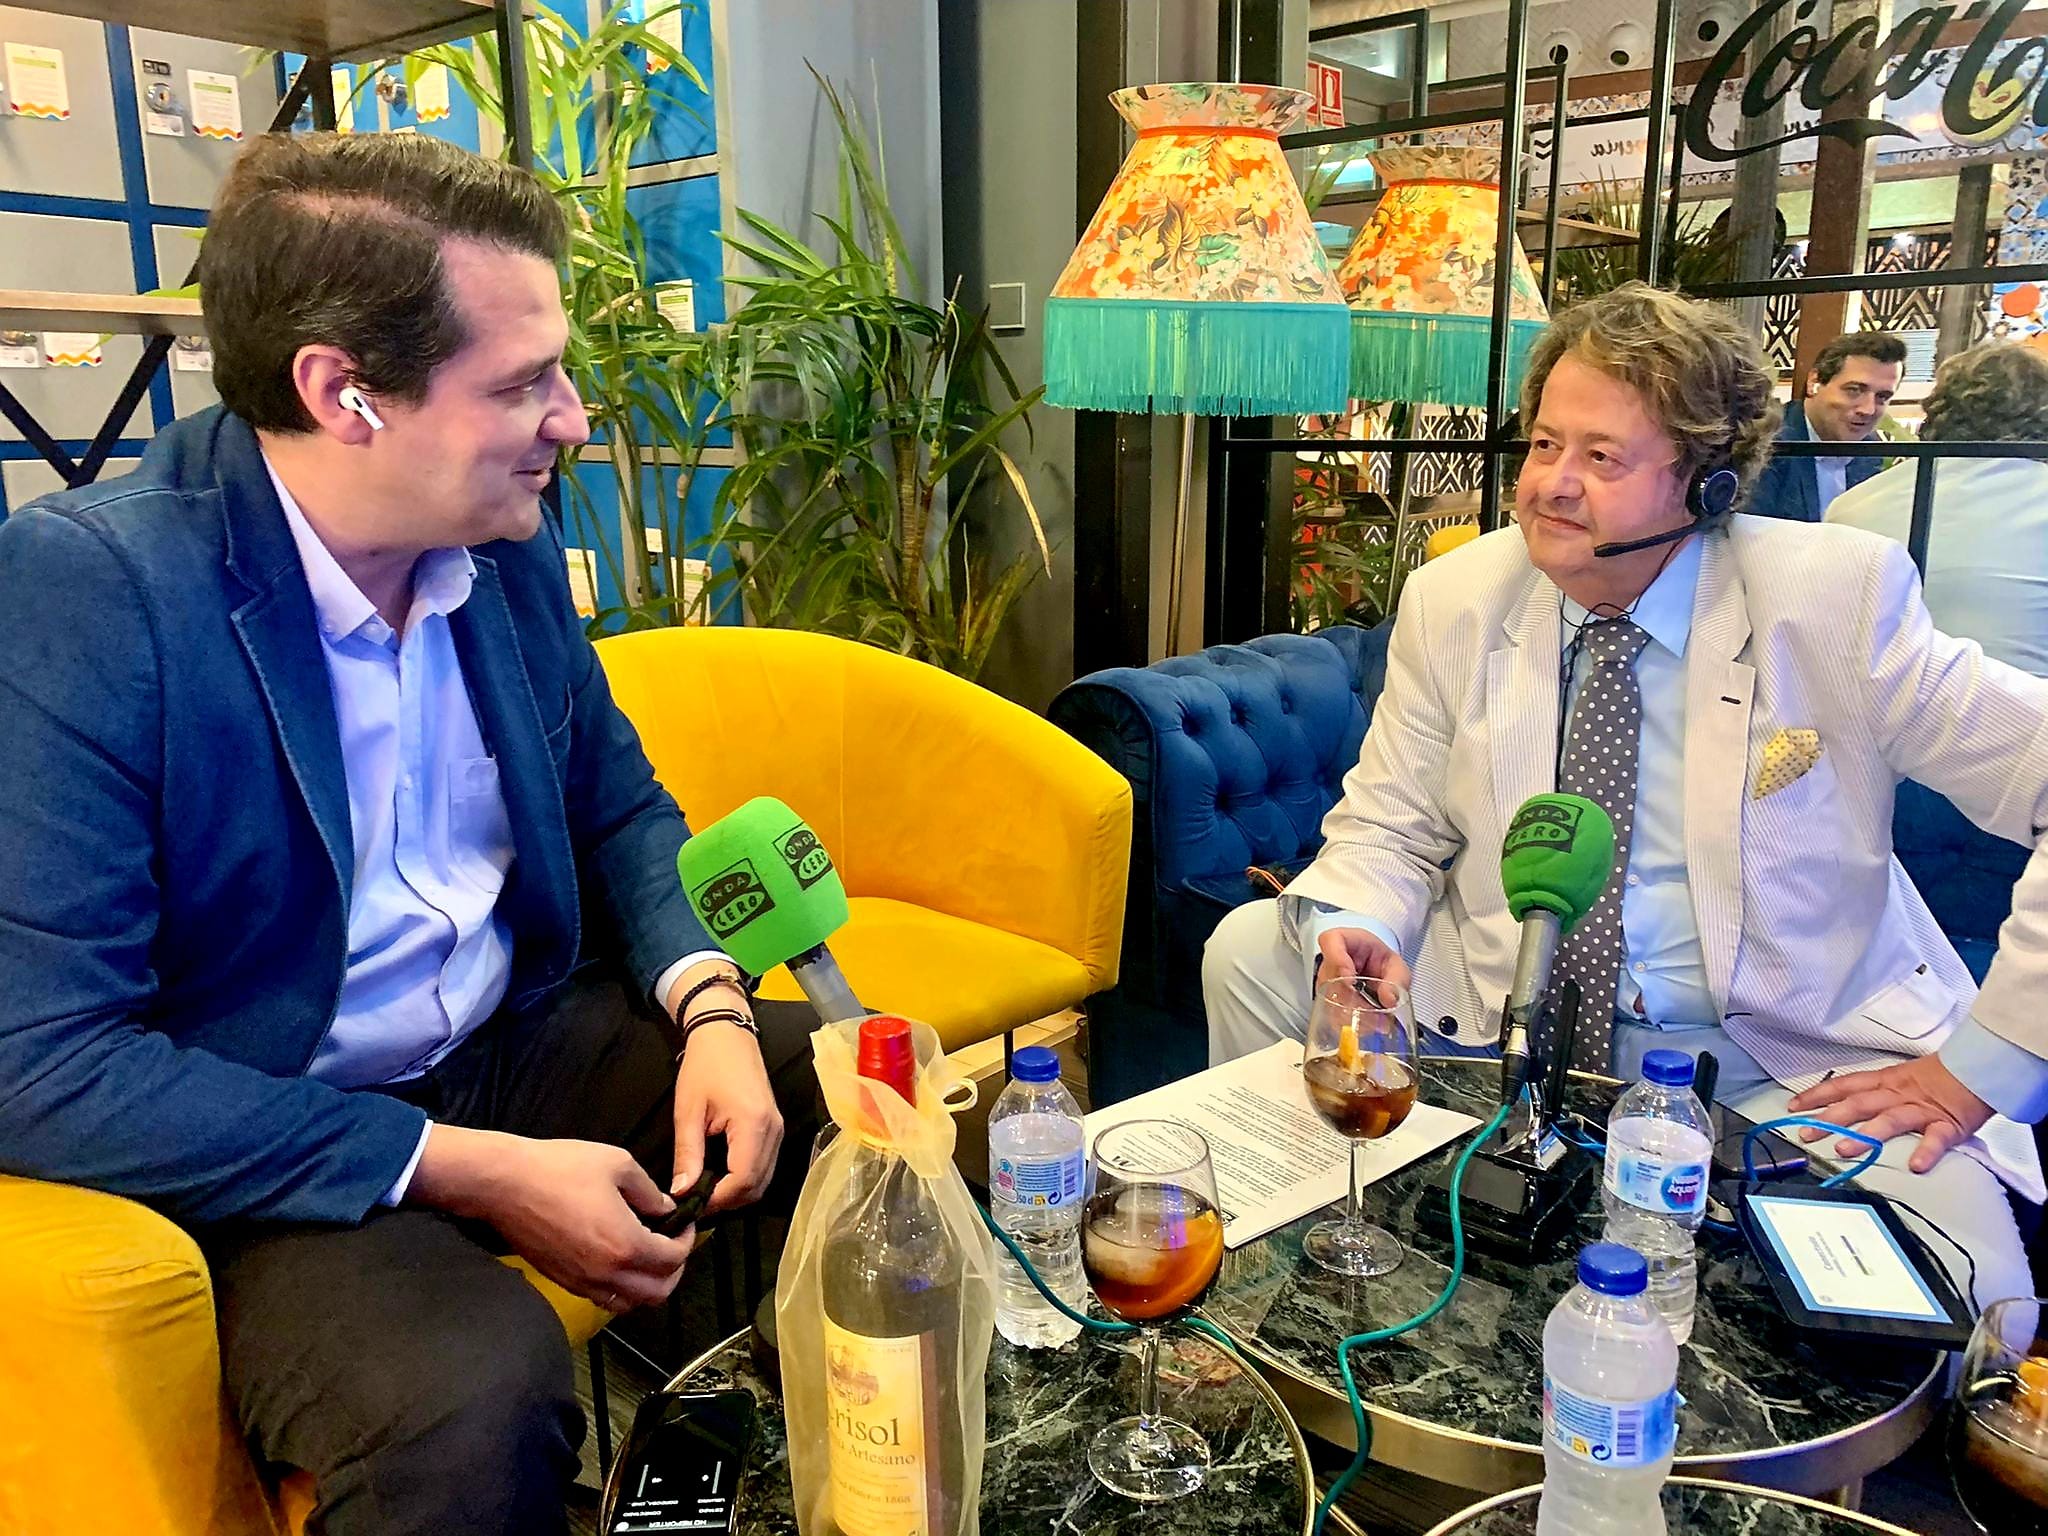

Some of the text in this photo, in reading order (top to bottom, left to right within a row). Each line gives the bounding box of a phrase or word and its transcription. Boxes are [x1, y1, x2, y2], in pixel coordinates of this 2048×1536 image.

[703, 876, 746, 908] ONDA
[716, 895, 758, 927] CERO
[830, 1408, 901, 1446] risol
